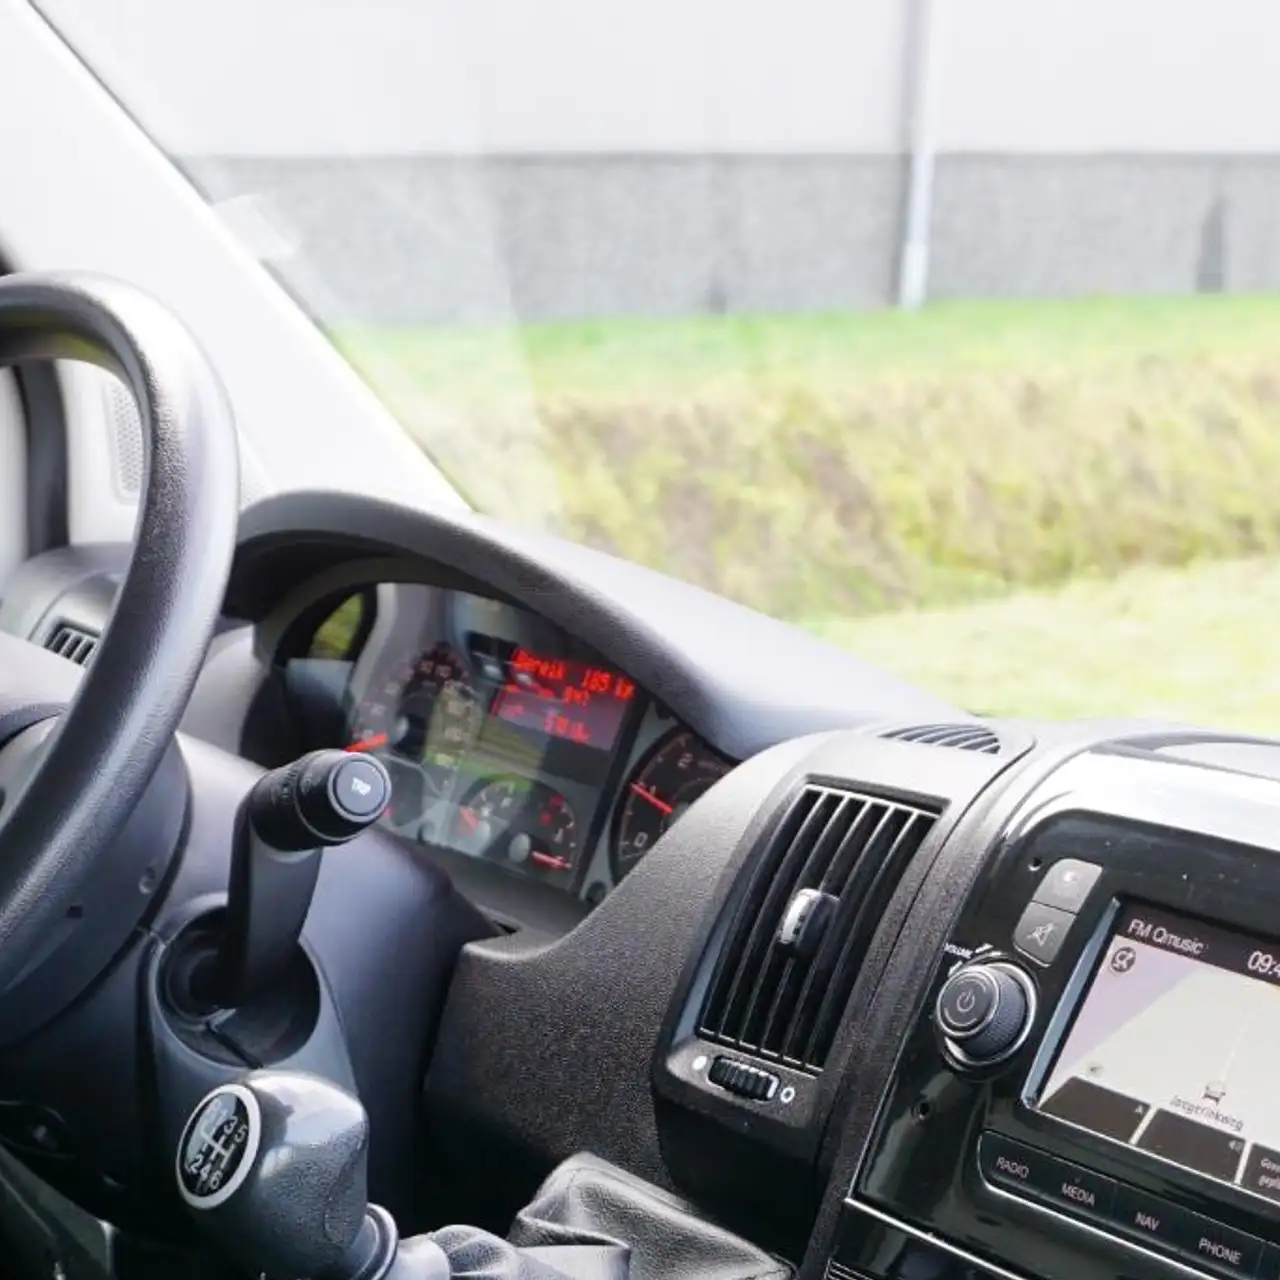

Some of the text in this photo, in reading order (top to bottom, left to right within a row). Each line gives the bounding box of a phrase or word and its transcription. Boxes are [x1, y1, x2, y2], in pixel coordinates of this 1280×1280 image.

[1127, 918, 1205, 955] FM Qmusic
[223, 1115, 248, 1142] 3 5
[190, 1153, 223, 1190] 2 4 6
[996, 1156, 1029, 1179] RADIO
[1062, 1183, 1095, 1207] MEDIA
[1135, 1211, 1160, 1231] NAV
[1198, 1237, 1243, 1265] PHONE
